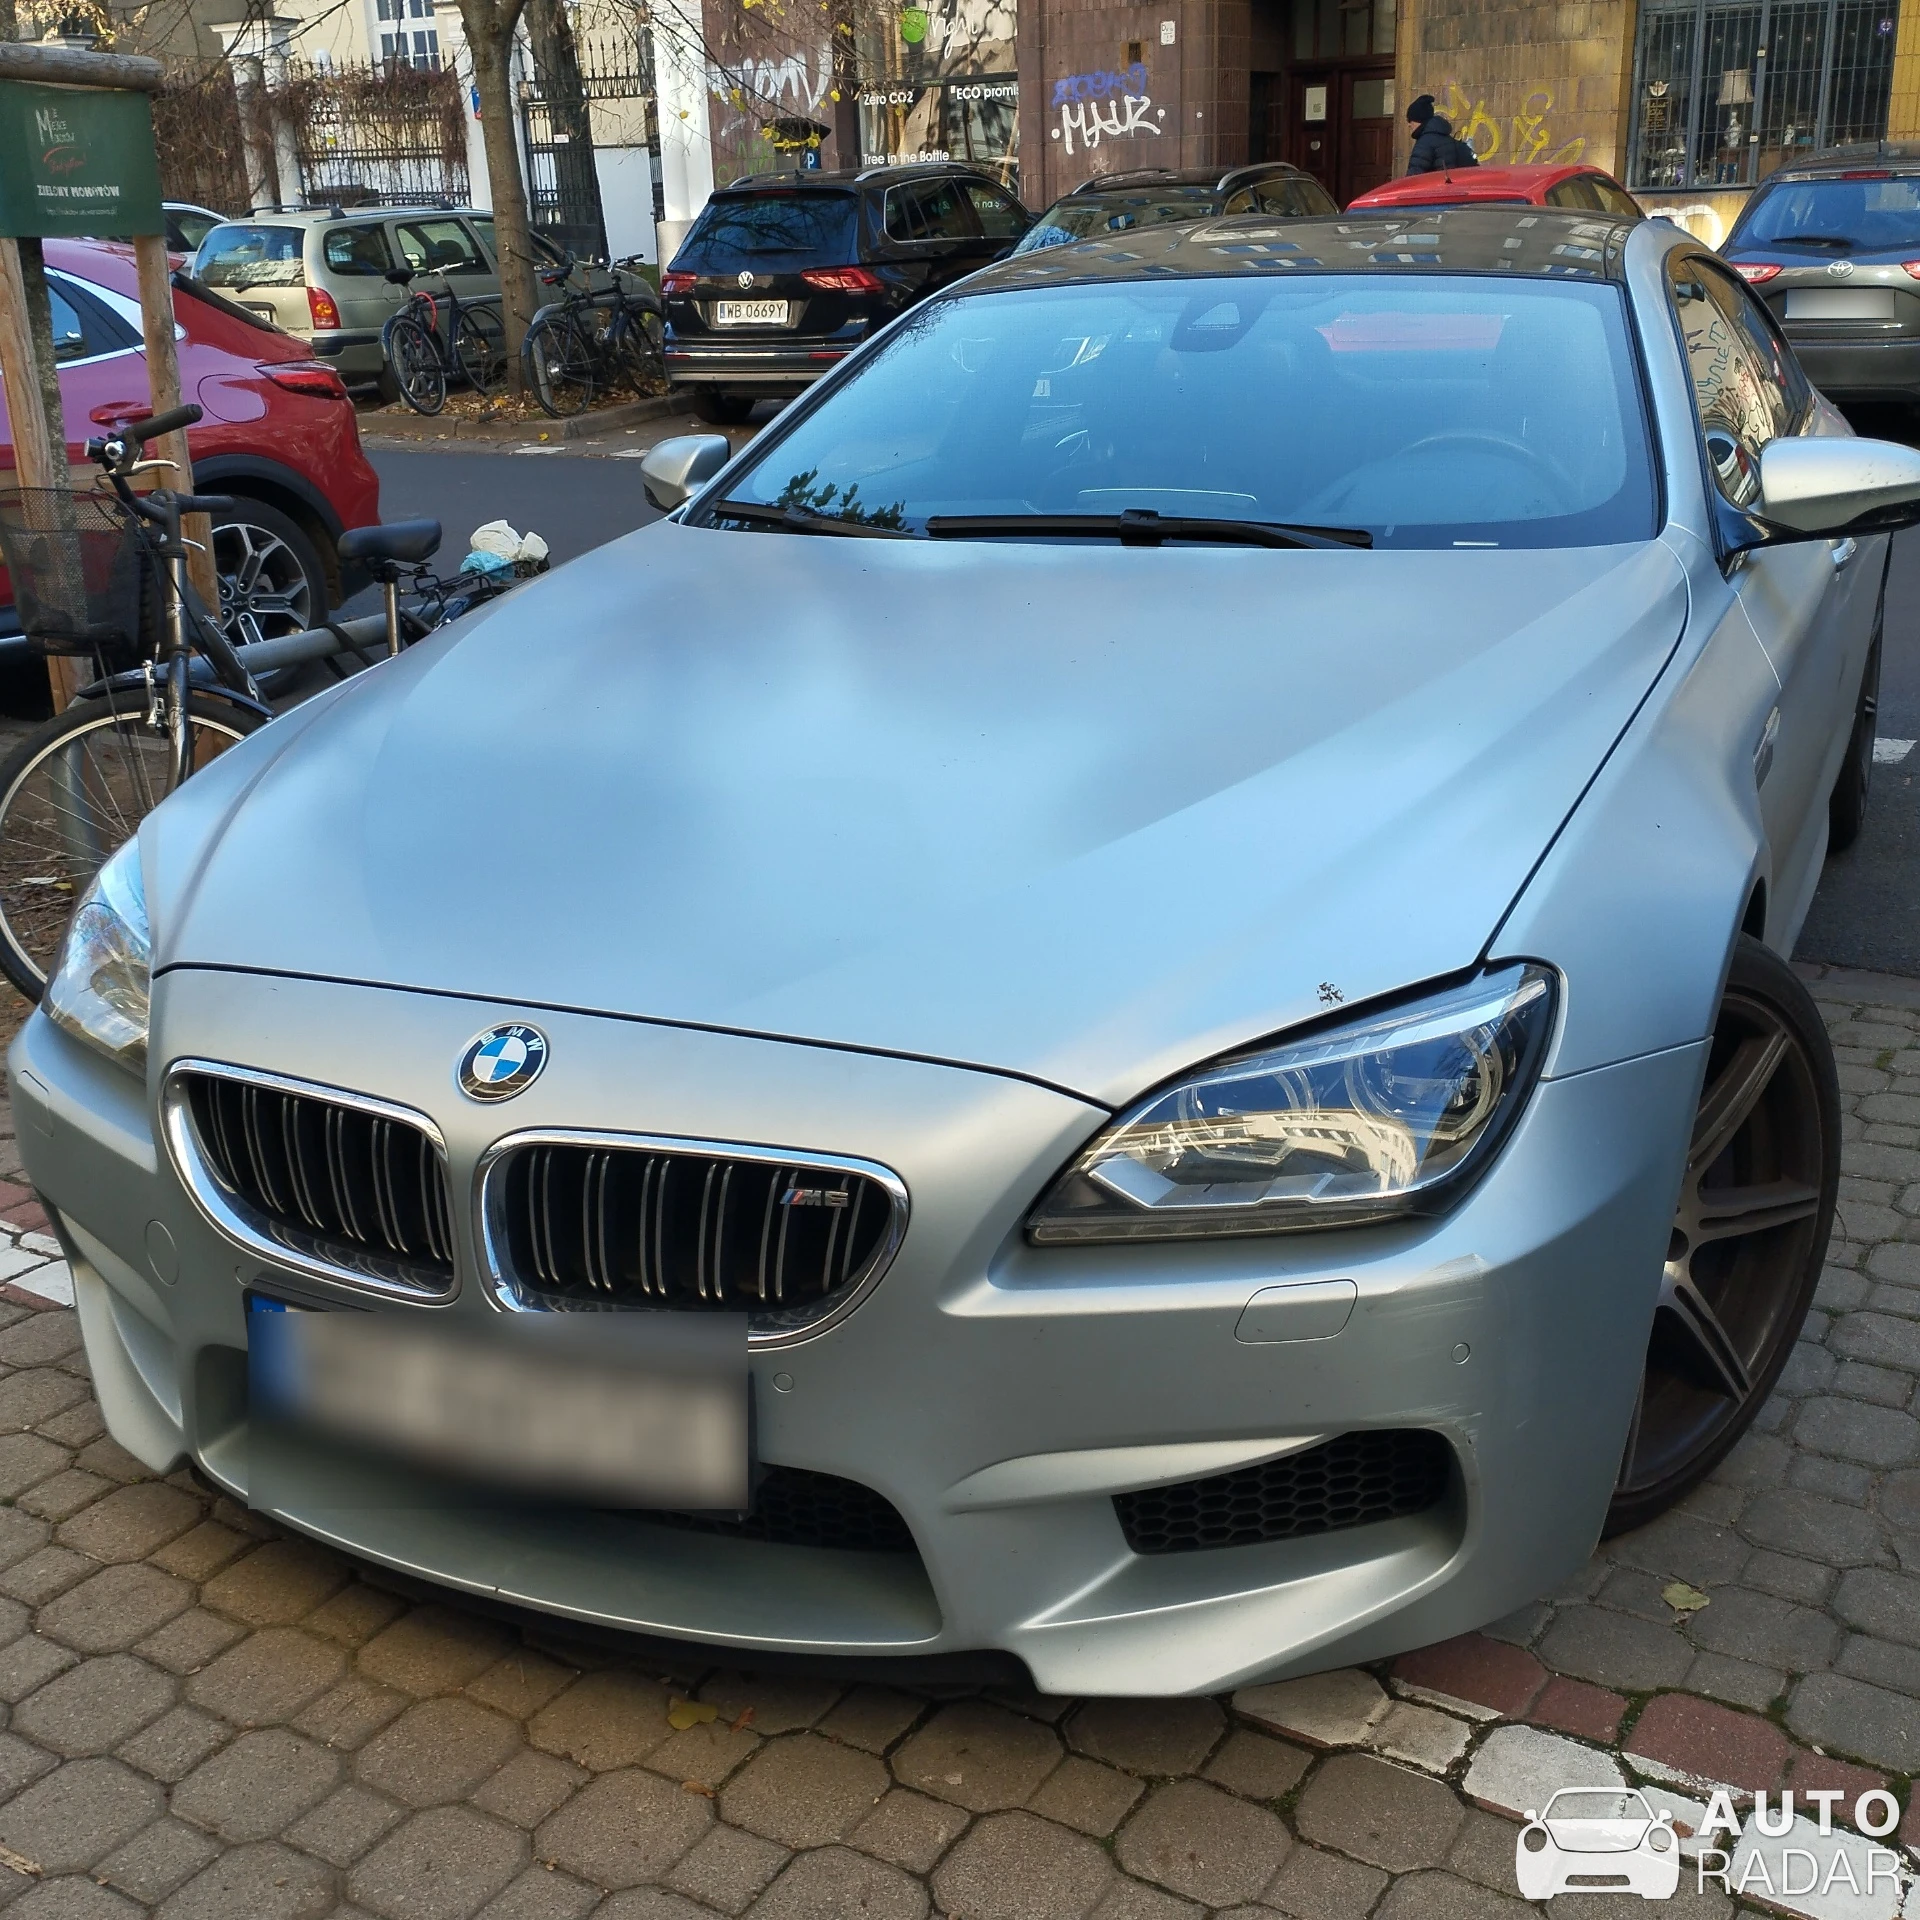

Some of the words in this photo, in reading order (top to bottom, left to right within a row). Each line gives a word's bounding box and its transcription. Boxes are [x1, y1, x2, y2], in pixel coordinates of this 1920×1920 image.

[864, 93, 887, 106] Zero
[889, 91, 913, 104] CO2
[984, 85, 1019, 100] promi
[863, 153, 885, 165] Tree
[888, 153, 897, 164] in
[900, 152, 917, 163] the
[919, 149, 950, 162] Bottle
[727, 304, 742, 318] WB
[746, 303, 784, 318] 0669Y
[480, 1026, 544, 1052] BMW
